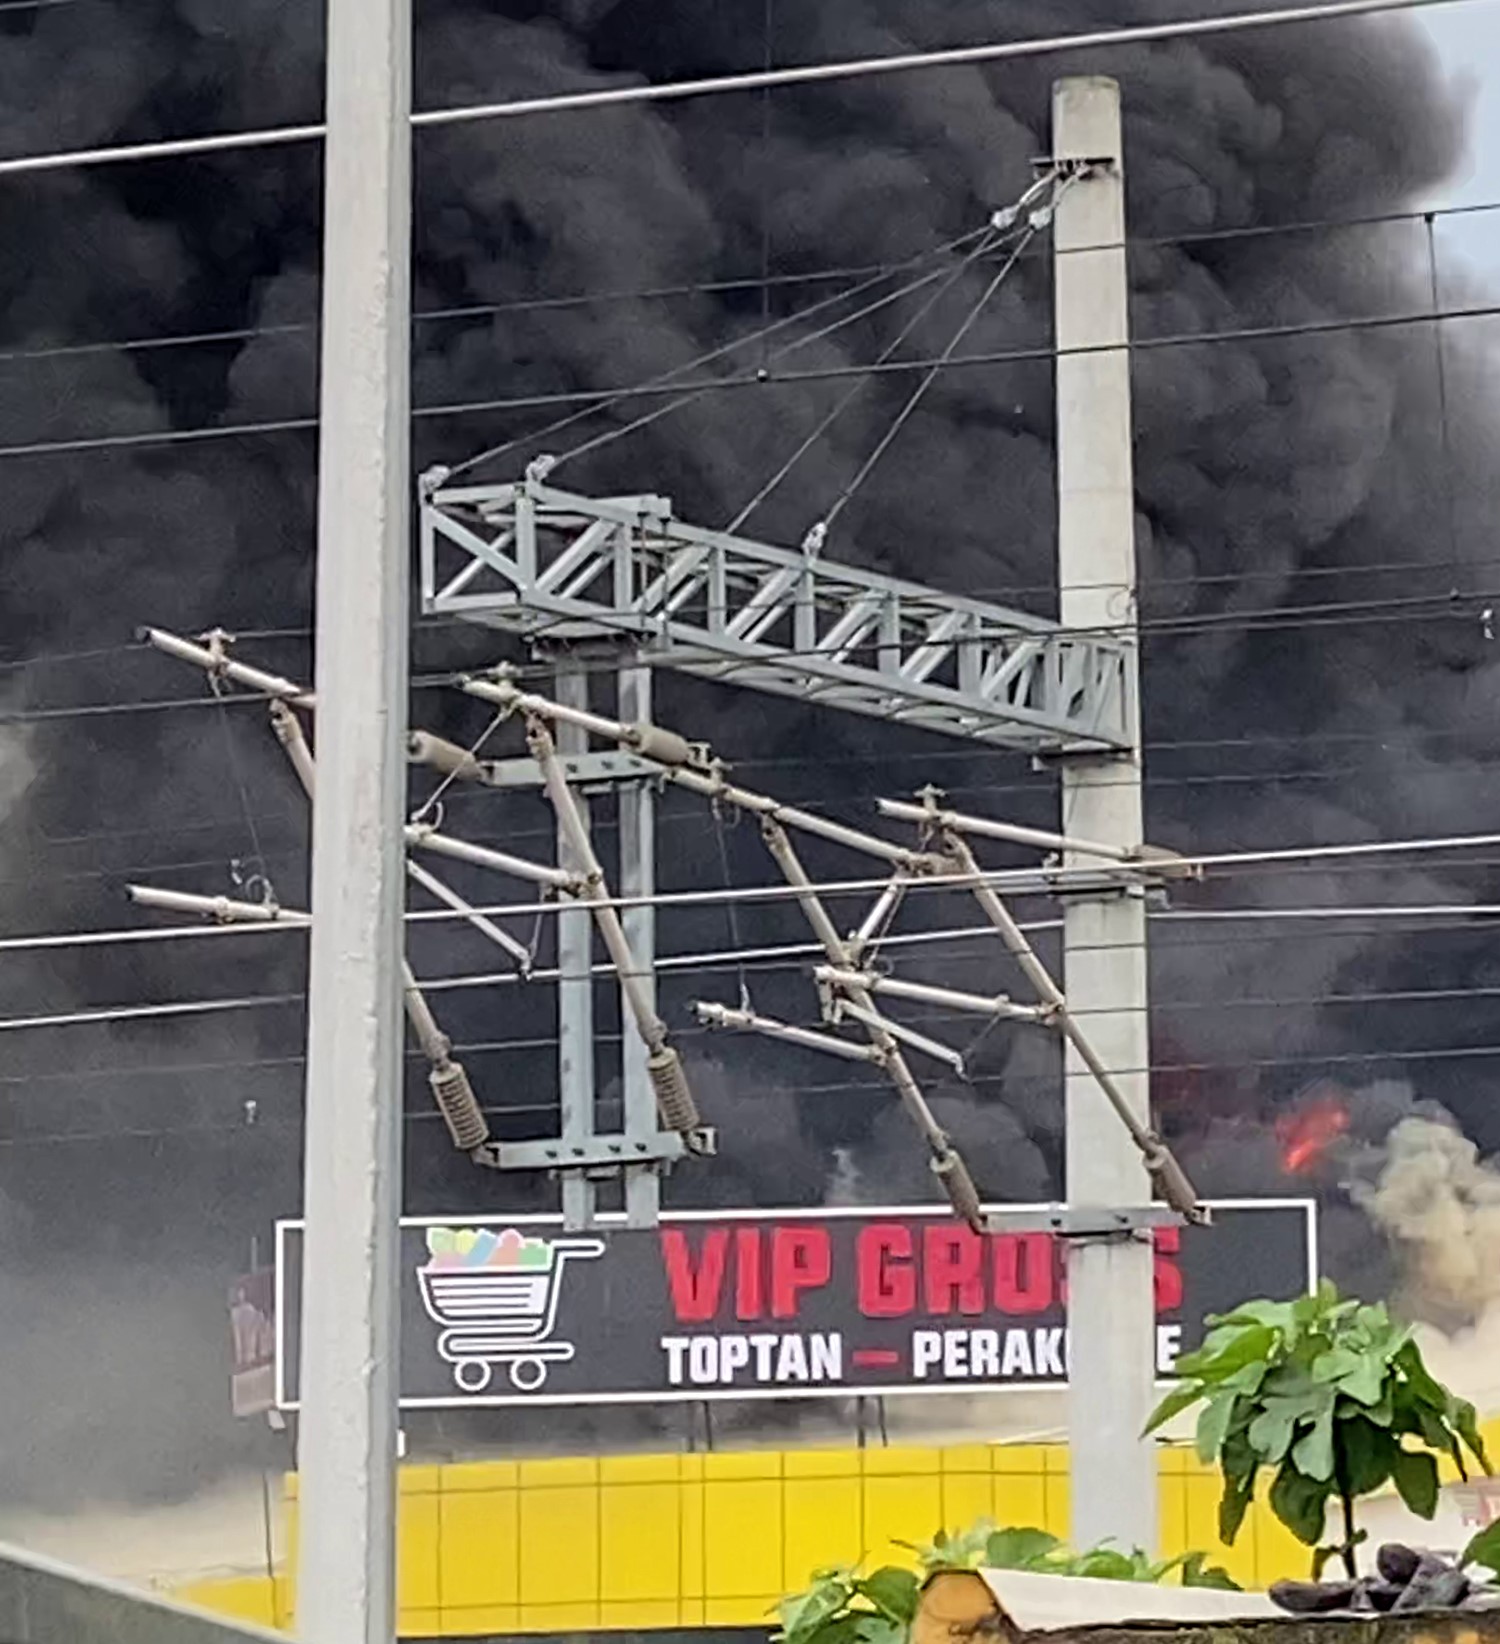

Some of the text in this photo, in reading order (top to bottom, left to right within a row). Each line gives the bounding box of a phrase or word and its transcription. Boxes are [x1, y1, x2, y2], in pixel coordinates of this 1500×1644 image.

[661, 1224, 1183, 1322] VIP GROS
[660, 1333, 842, 1384] TOPTAN
[912, 1325, 1182, 1378] PERAKE
